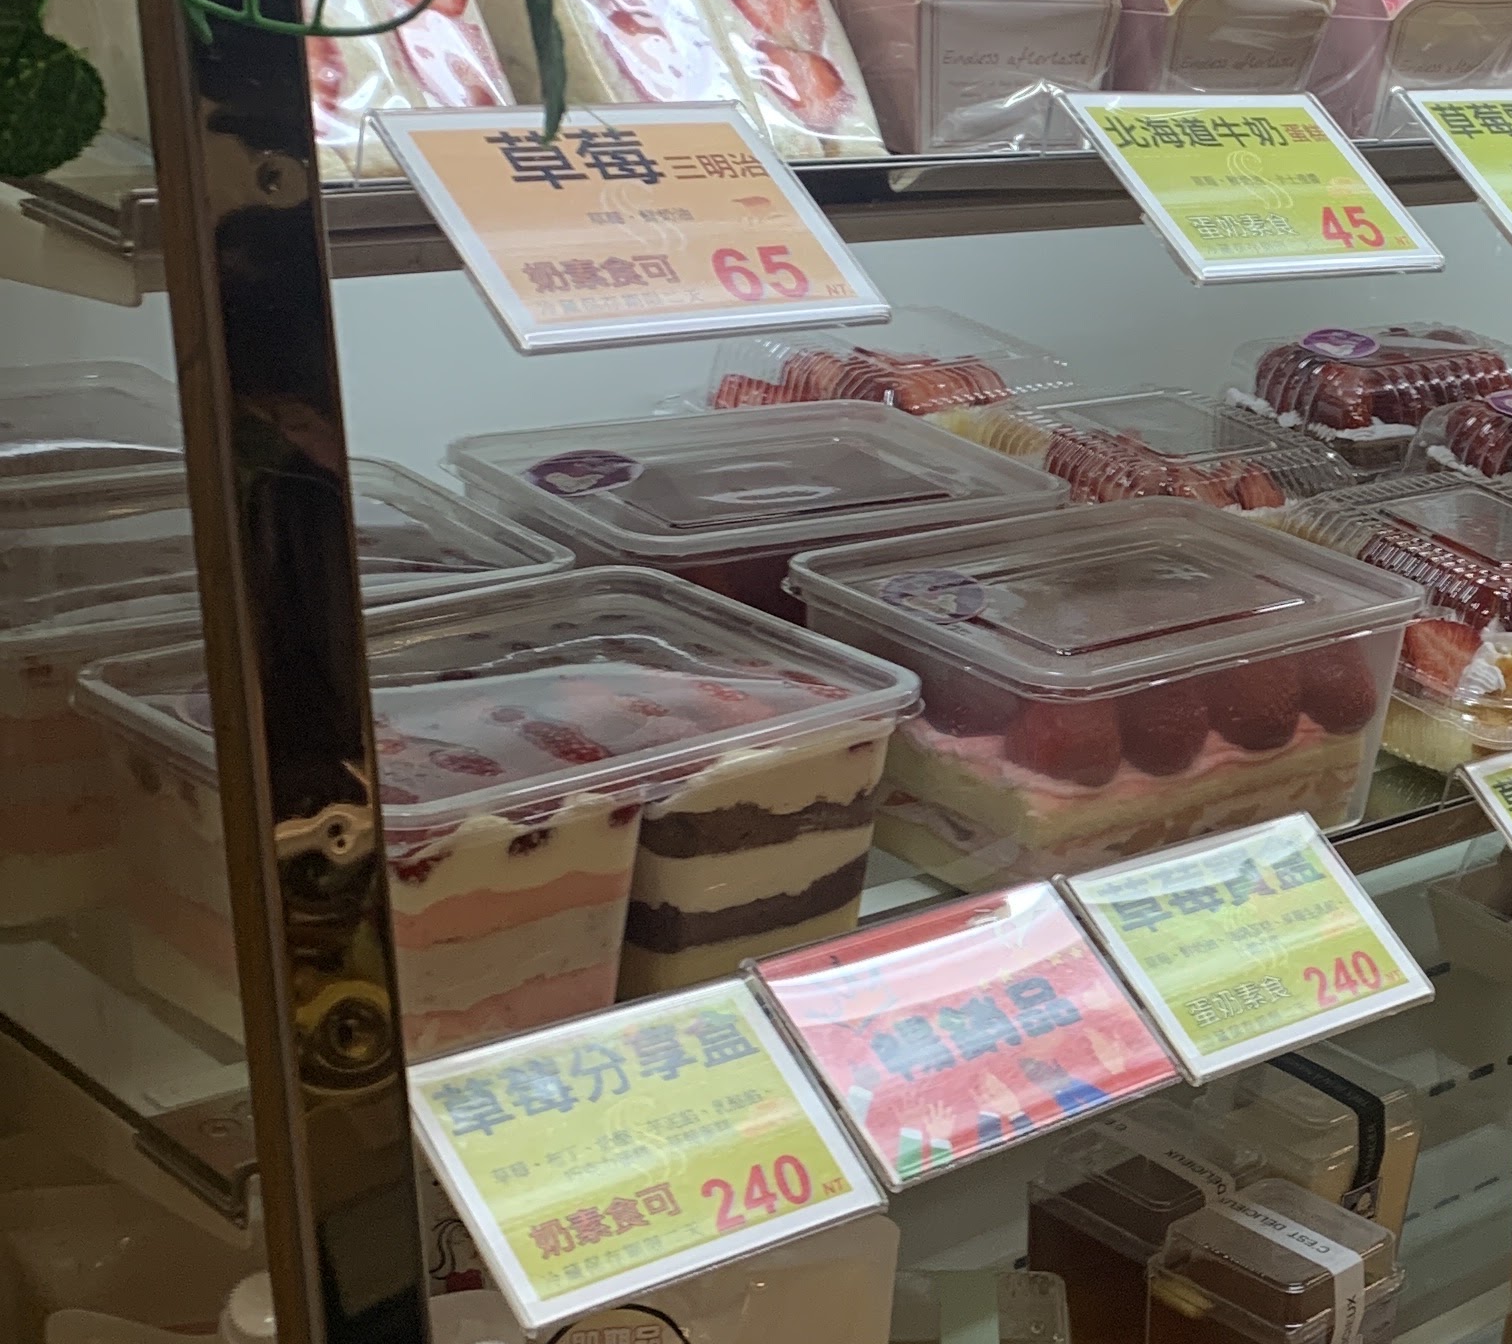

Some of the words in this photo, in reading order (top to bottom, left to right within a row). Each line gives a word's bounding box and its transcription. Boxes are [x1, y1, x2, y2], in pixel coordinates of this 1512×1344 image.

[480, 128, 671, 190] 草莓
[660, 152, 771, 182] 三明治
[1094, 113, 1291, 150] 北海道牛奶
[1280, 123, 1331, 142] 蛋糕
[1184, 212, 1299, 239] 蛋奶素食
[1301, 206, 1394, 248] 45
[699, 244, 821, 302] 65
[1185, 974, 1292, 1028] 蛋奶素食
[1302, 951, 1382, 1009] 240
[426, 999, 760, 1147] 草莓分享盒
[525, 1181, 685, 1262] 奶素食可
[692, 1150, 823, 1235] 240
[819, 1177, 846, 1196] NT
